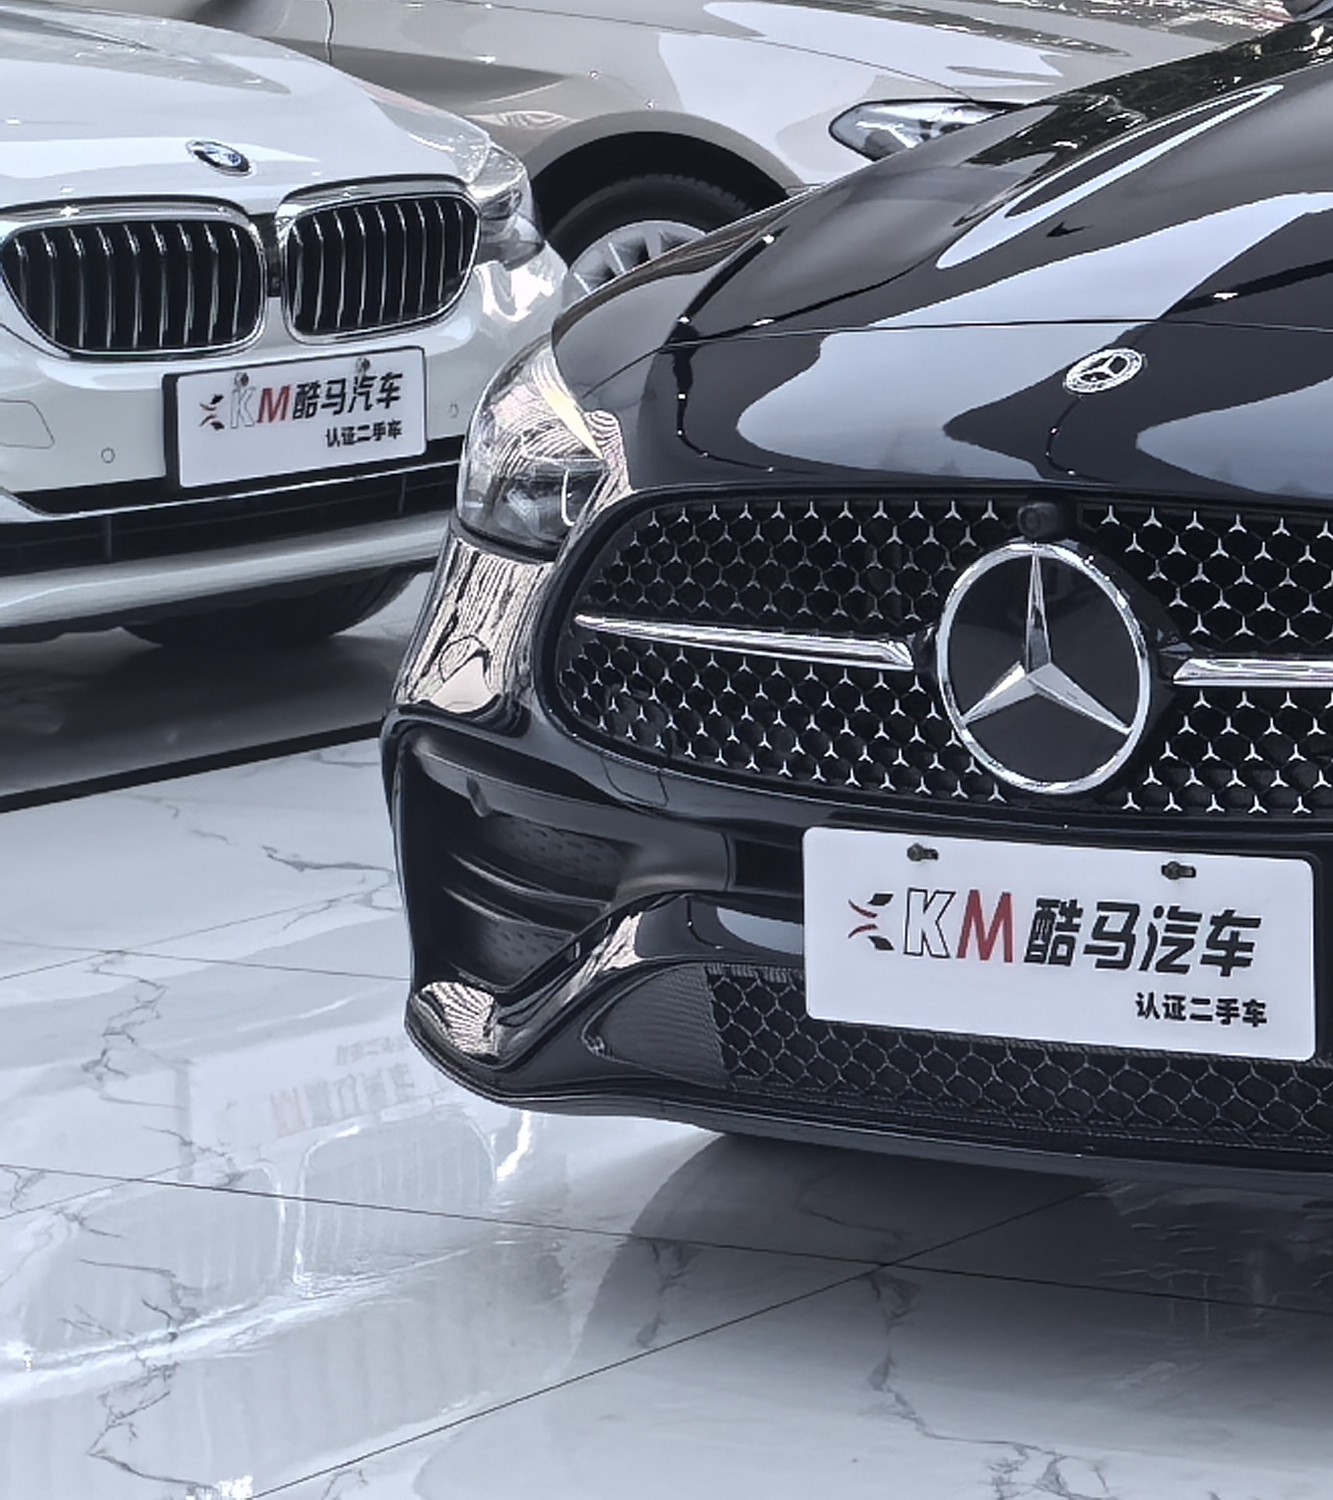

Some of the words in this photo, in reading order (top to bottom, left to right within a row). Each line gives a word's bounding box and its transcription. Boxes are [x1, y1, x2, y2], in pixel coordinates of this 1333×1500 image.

[292, 371, 404, 421] 酷马汽车
[325, 420, 403, 448] 认证二手车
[903, 887, 1014, 964] KM
[1022, 897, 1262, 978] 酷马汽车
[1134, 991, 1268, 1028] 认证二手车
